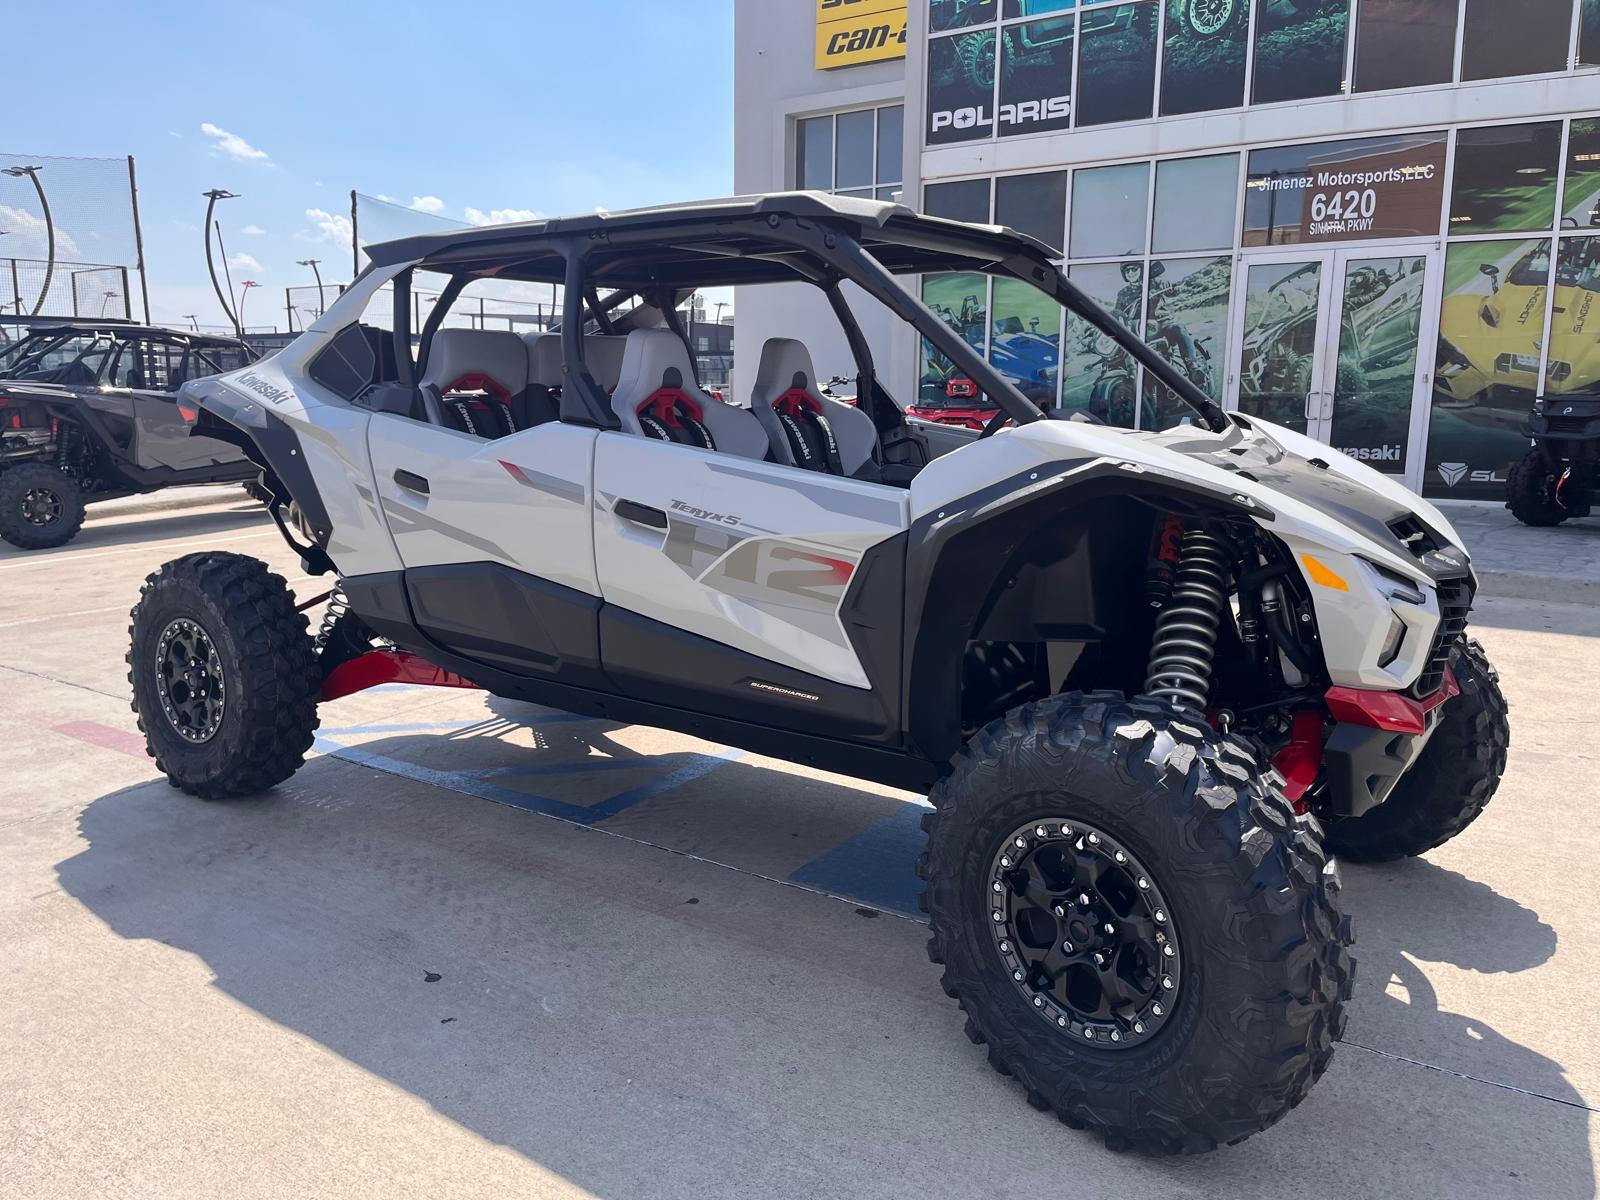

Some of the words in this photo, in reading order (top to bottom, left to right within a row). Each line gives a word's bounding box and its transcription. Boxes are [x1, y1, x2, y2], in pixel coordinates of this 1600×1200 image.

[932, 95, 1071, 132] POLARIS
[1258, 175, 1314, 192] Jimenez
[1311, 188, 1377, 222] 6420
[1309, 220, 1345, 235] SINATRA
[1347, 217, 1374, 232] PKWY
[234, 370, 295, 404] Kawasaki
[780, 414, 812, 460] Kawasaki
[750, 682, 819, 701] SUPERCHARGED
